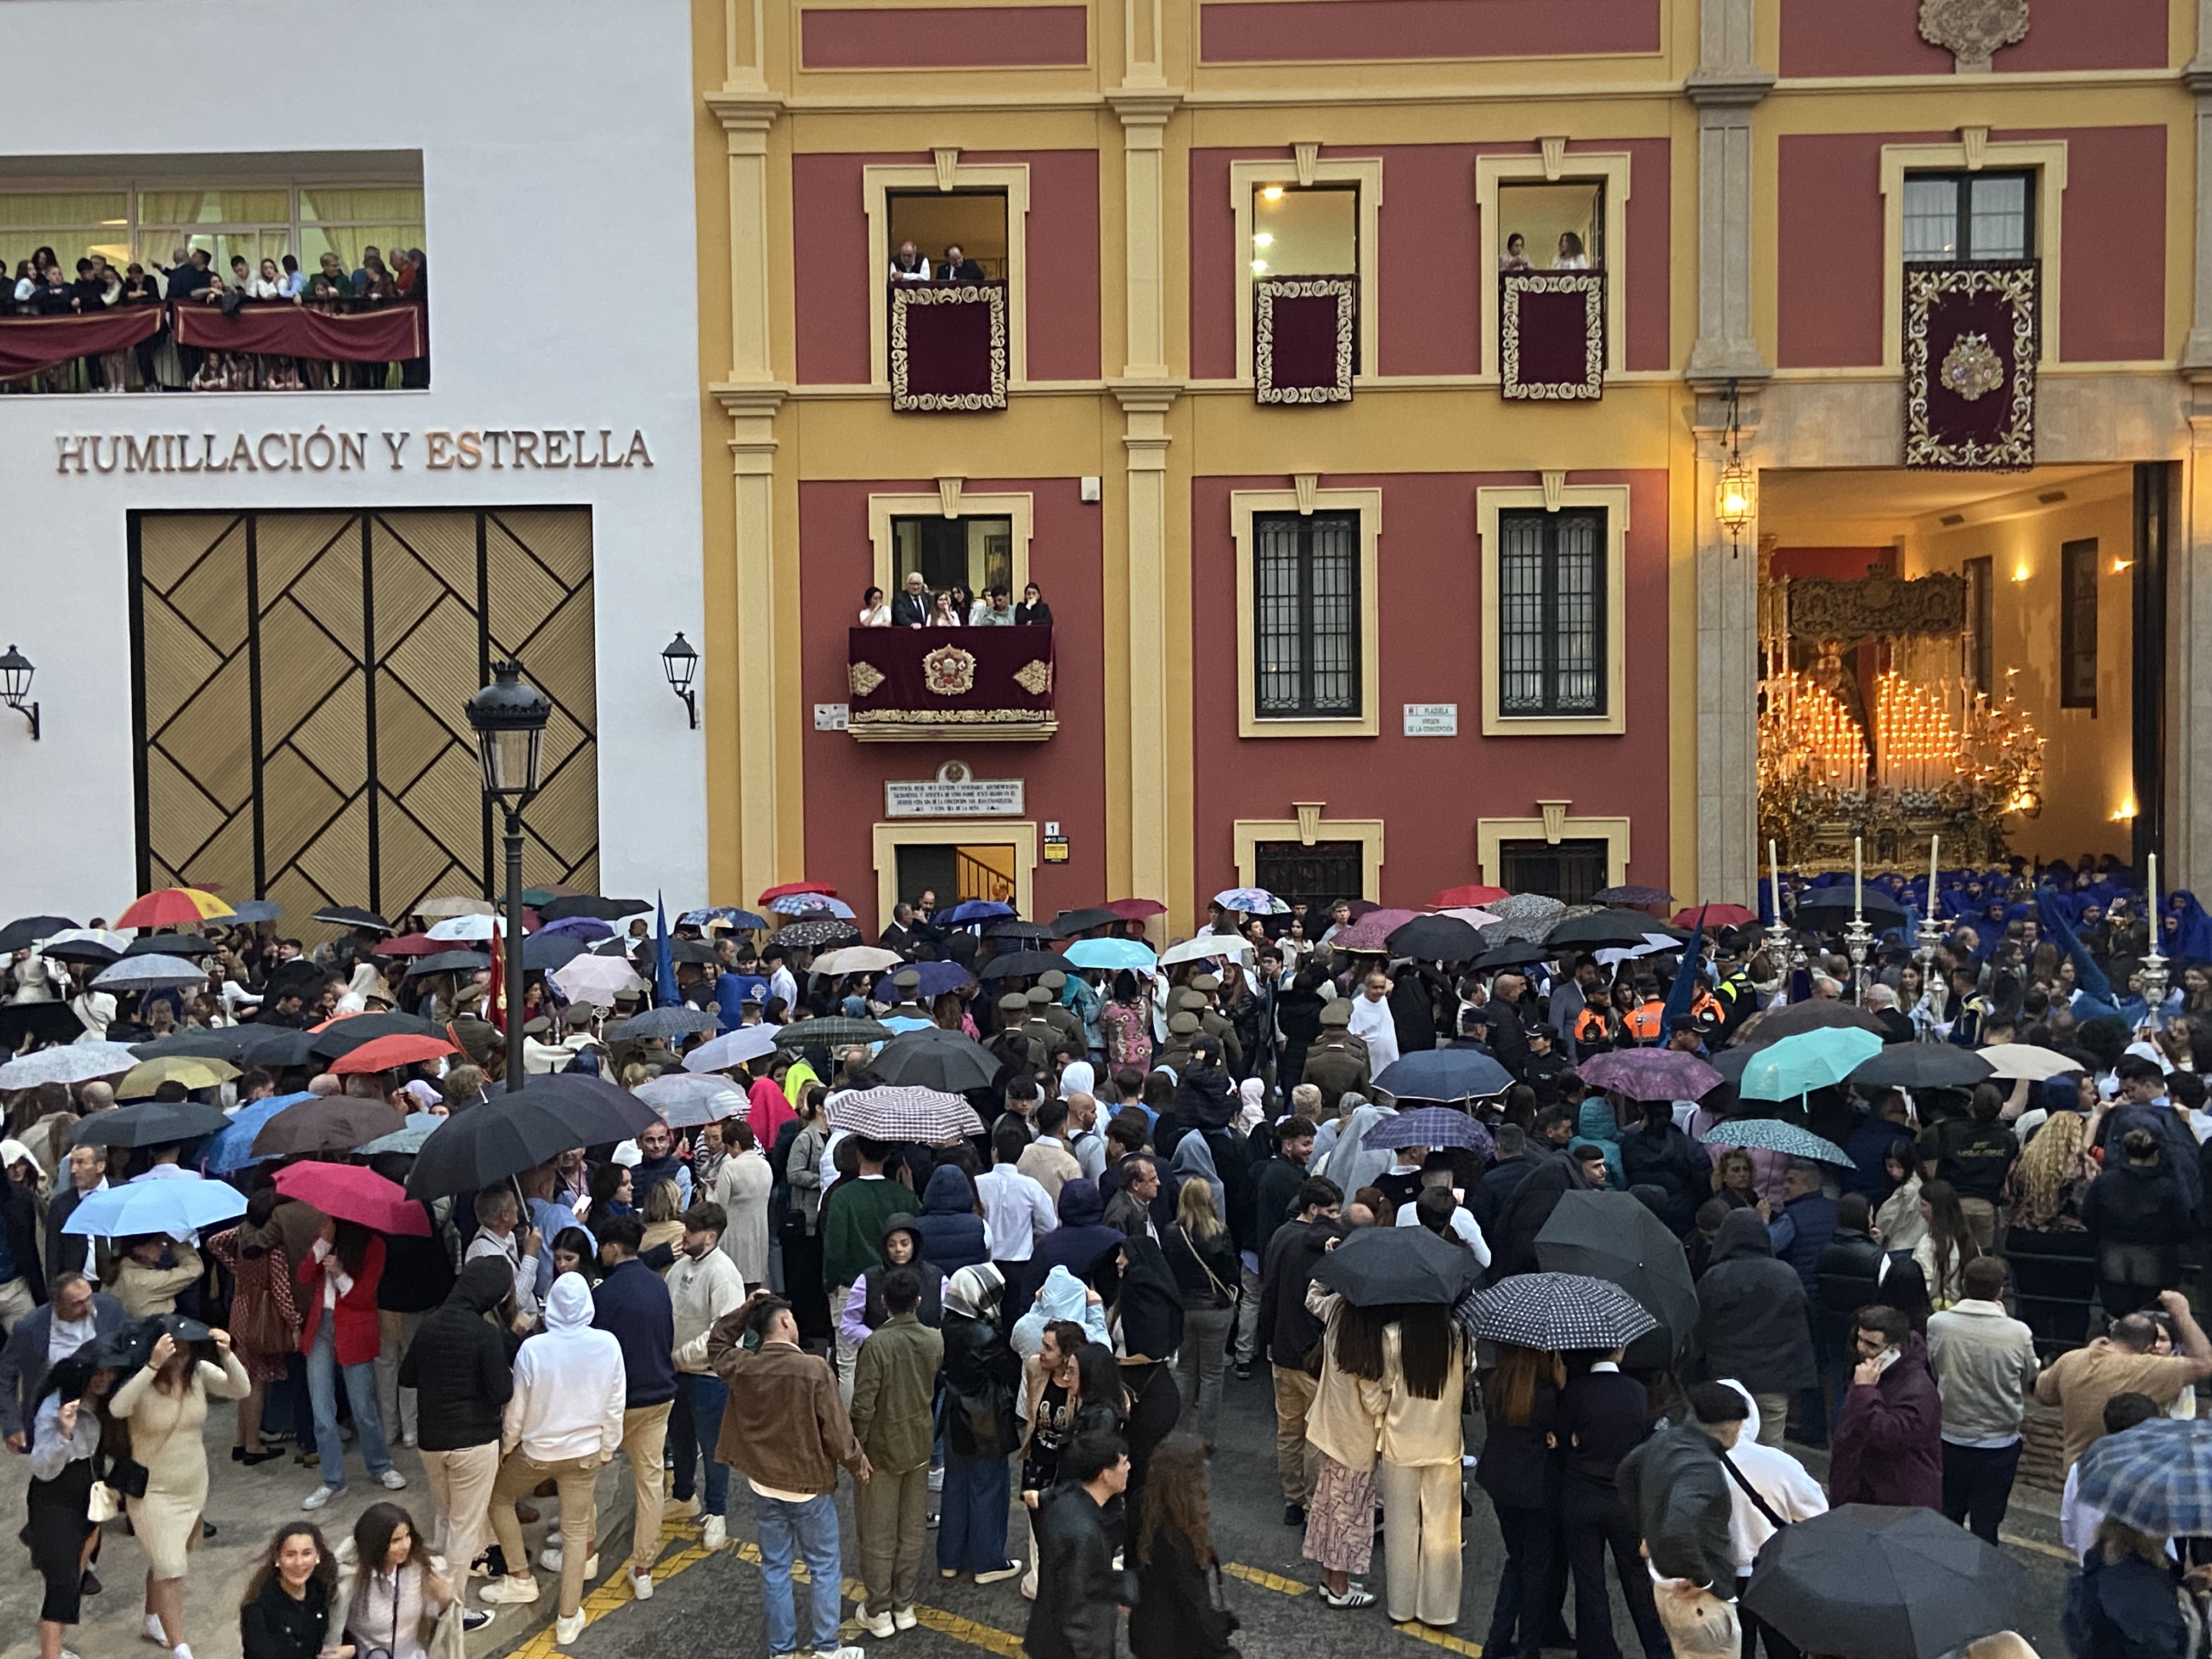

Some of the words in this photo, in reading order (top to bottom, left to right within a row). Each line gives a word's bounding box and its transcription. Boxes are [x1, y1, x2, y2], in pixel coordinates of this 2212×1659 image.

[55, 424, 368, 474] HUMILLACIÓN
[382, 431, 409, 471] Y
[426, 429, 654, 470] ESTRELLA
[1049, 825, 1054, 834] 1
